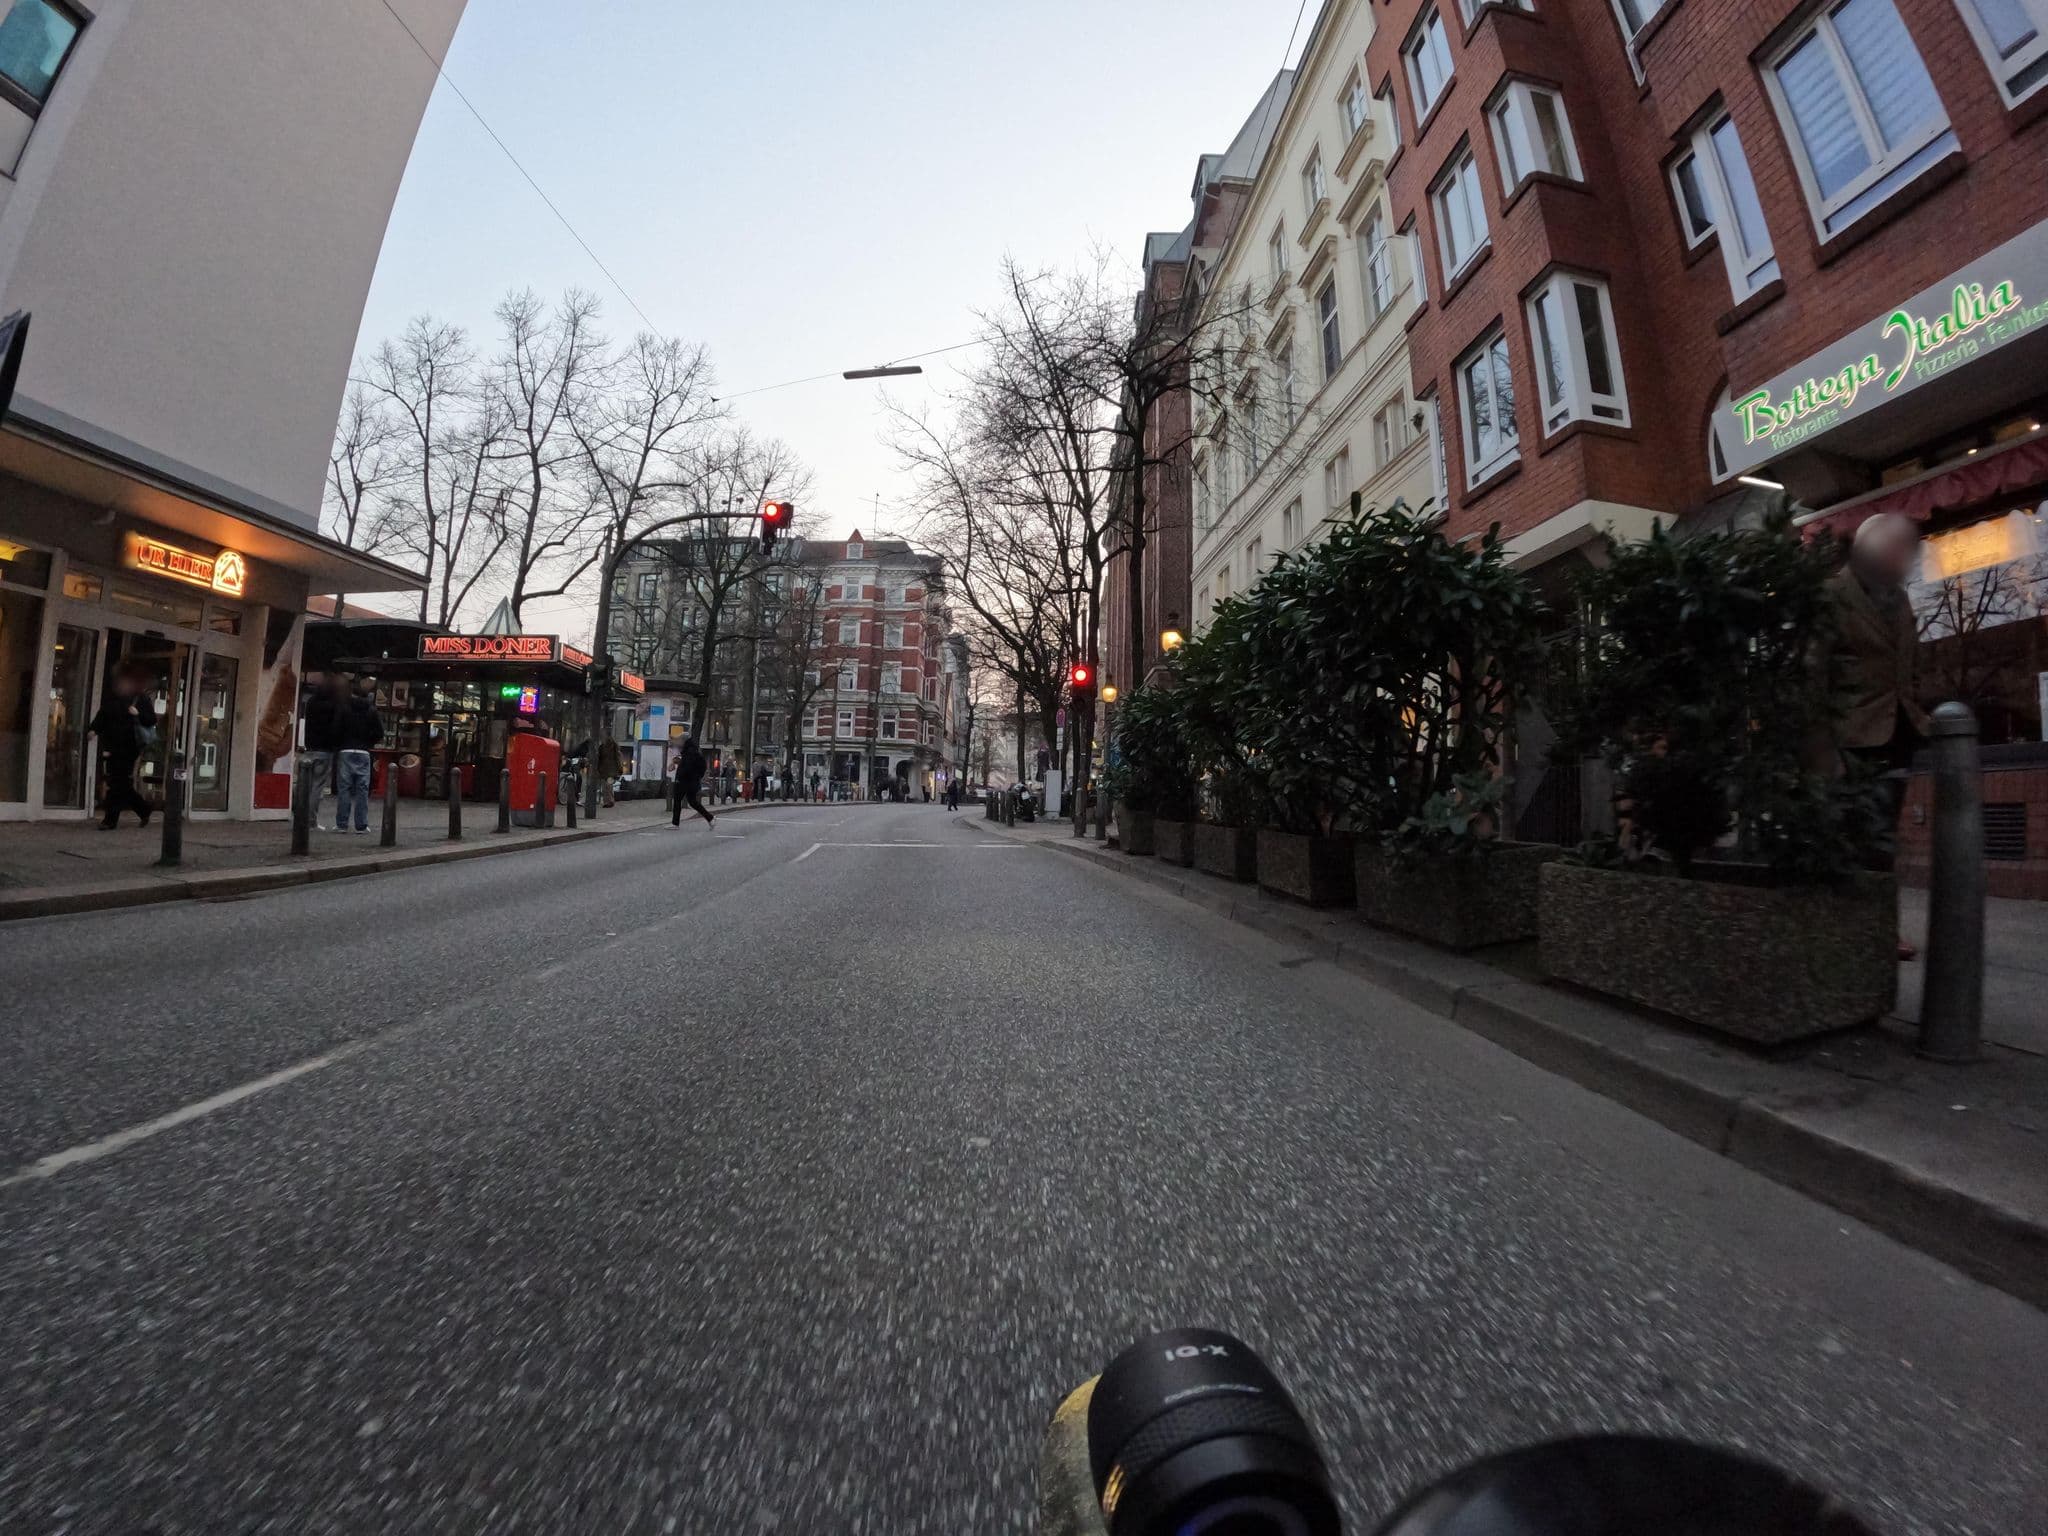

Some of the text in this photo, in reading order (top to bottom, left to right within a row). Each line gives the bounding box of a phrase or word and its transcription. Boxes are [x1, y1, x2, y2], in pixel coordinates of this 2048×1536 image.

[1733, 280, 2022, 444] Bottega Italia
[1771, 409, 1840, 450] Ristorante
[1913, 338, 1980, 379] Pizzeria
[168, 551, 212, 581] HIER
[424, 635, 552, 654] MISS DÖNER
